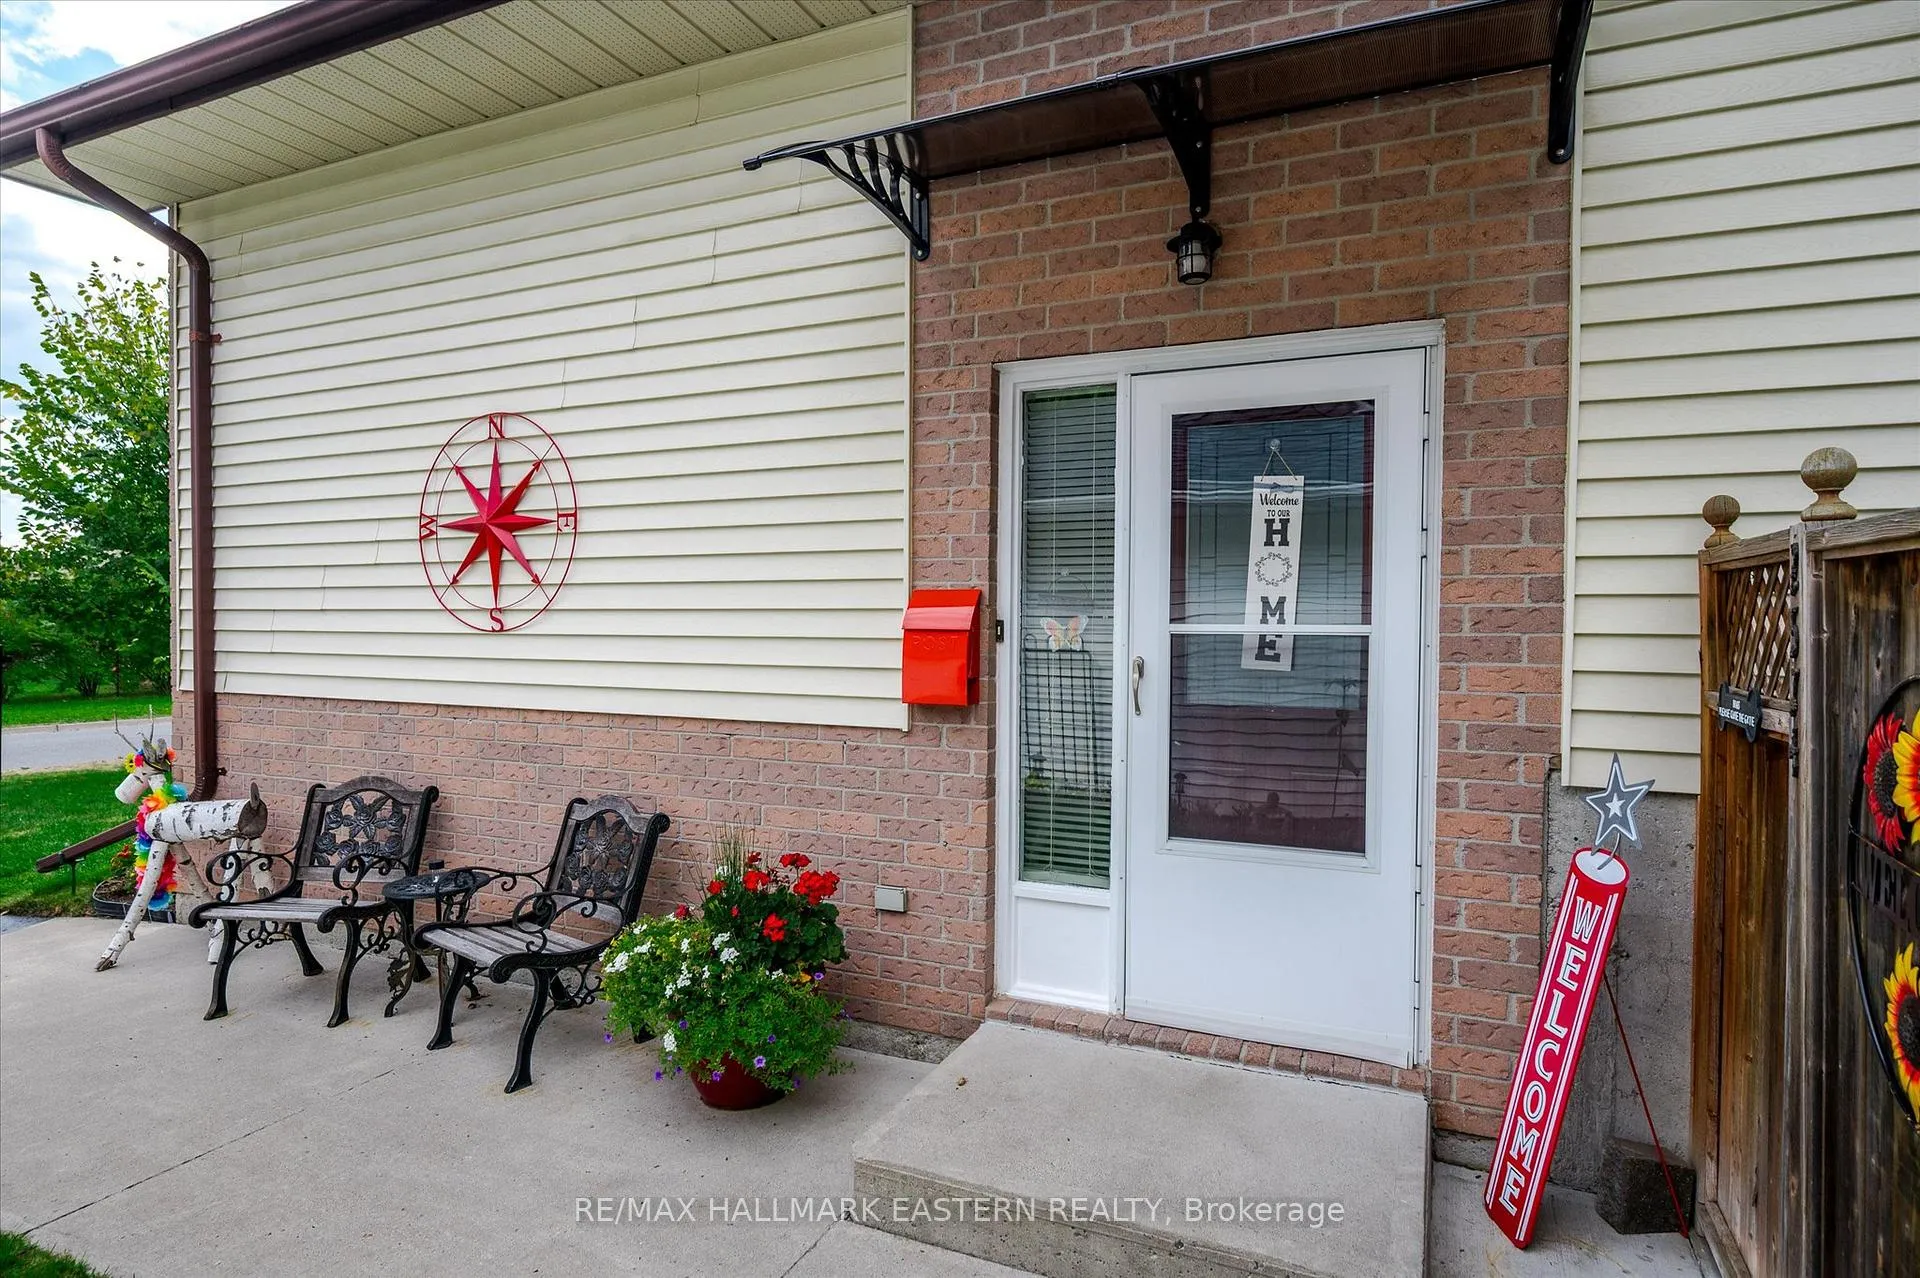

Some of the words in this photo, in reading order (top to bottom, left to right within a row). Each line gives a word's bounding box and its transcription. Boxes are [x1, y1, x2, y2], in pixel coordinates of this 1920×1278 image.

[486, 414, 506, 440] N
[1260, 493, 1300, 507] Welcome
[1267, 509, 1277, 518] TO
[1277, 509, 1291, 518] OUR
[489, 607, 505, 632] S
[912, 635, 959, 651] POST
[1498, 895, 1603, 1217] WELCOME
